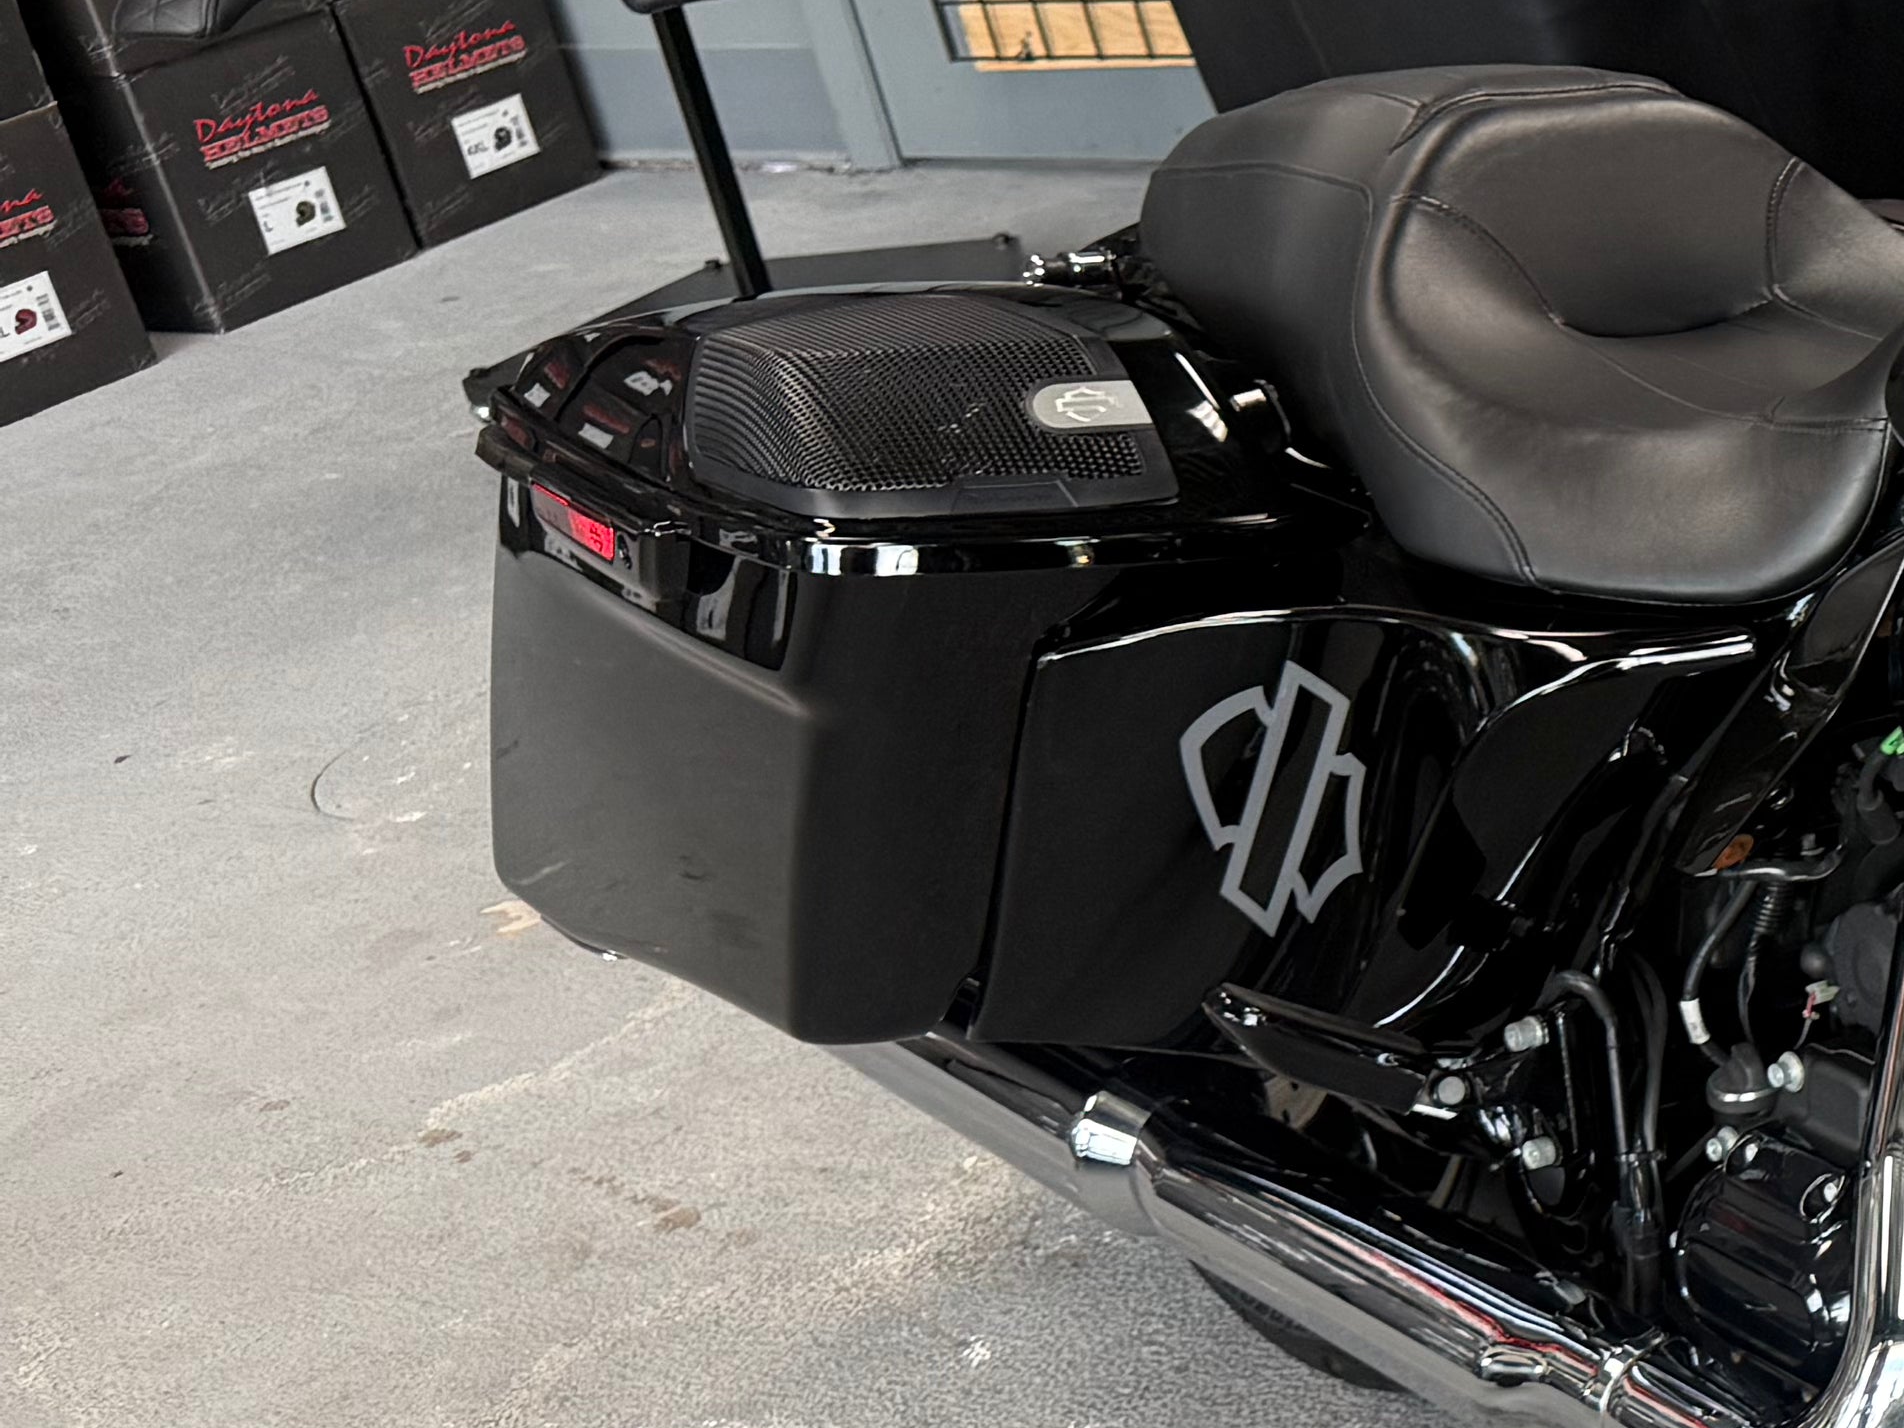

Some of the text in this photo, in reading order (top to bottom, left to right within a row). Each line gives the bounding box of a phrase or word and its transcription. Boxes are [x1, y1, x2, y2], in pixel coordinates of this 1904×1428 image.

[403, 20, 517, 69] Daytona
[409, 35, 527, 89] HELMETS
[193, 88, 320, 143] Daytona
[200, 105, 331, 164] HELMETS
